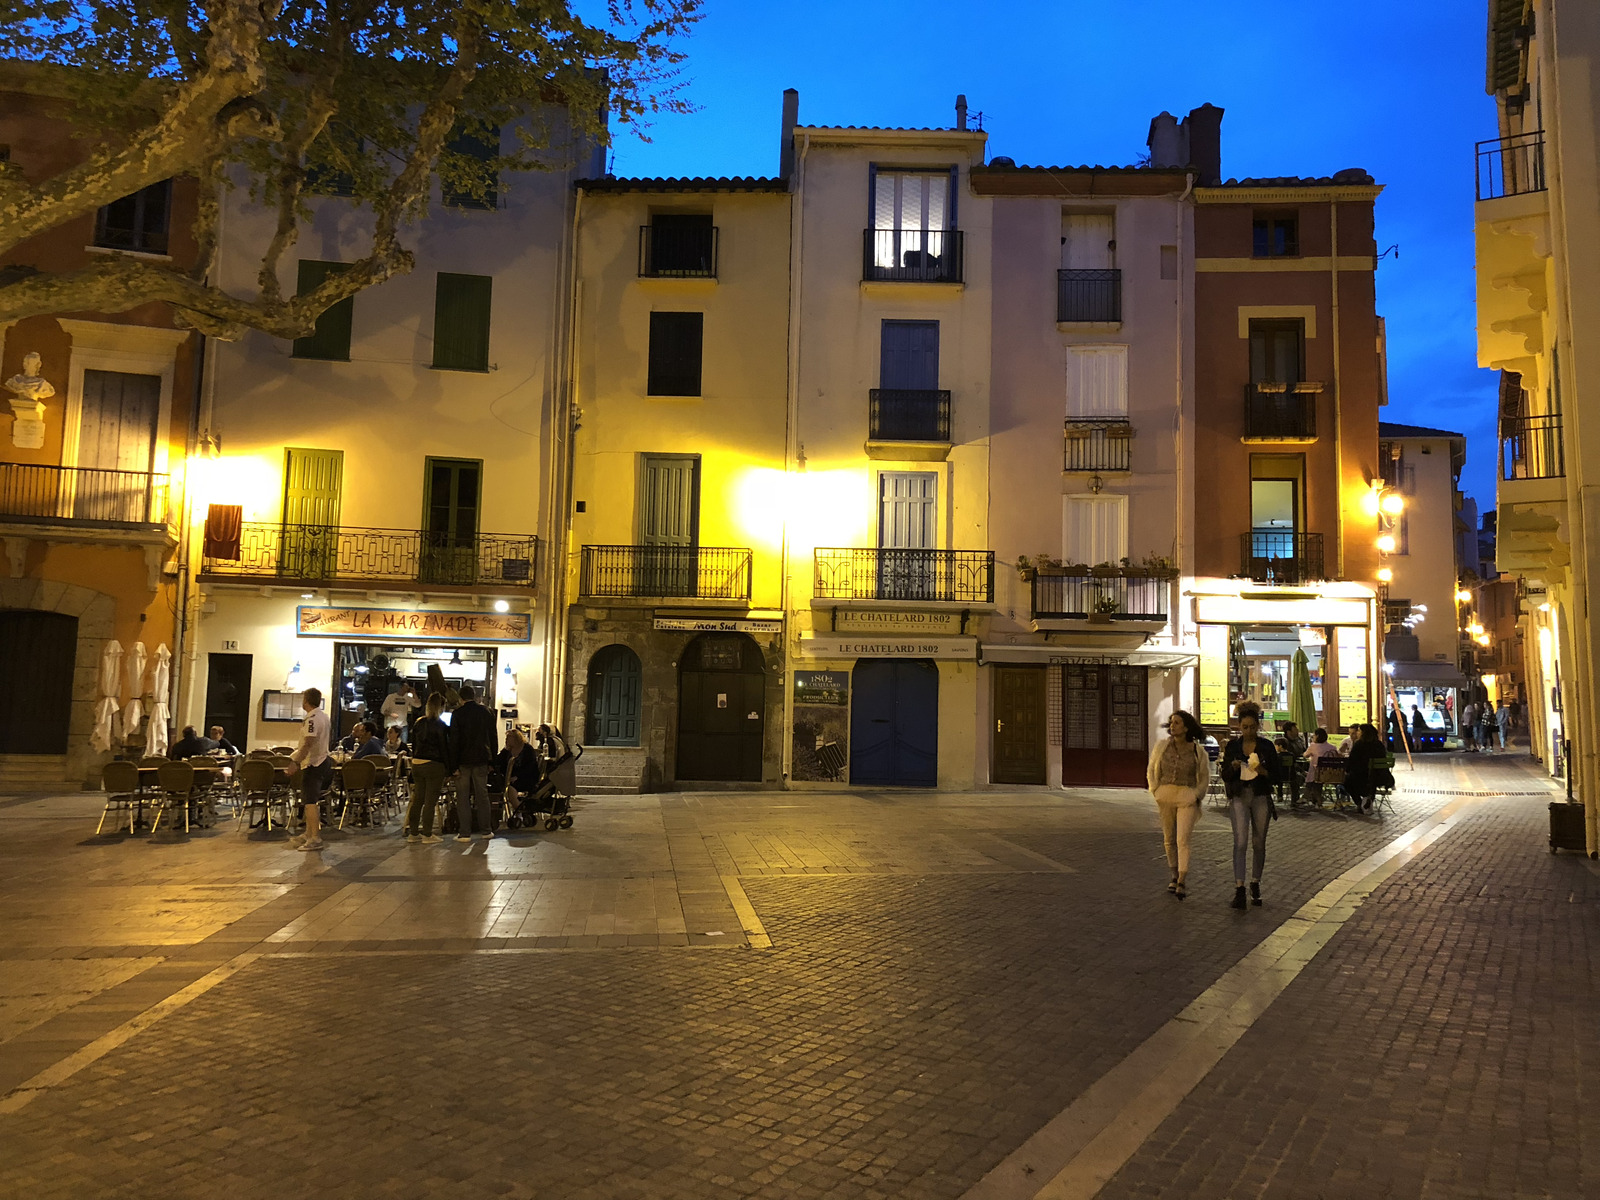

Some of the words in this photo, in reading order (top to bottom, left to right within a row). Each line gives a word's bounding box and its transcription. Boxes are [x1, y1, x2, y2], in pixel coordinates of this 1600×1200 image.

[844, 613, 856, 621] LE
[861, 613, 925, 623] CHATELARD
[928, 615, 950, 623] 1802
[301, 611, 351, 632] RESTAURANT
[353, 612, 372, 628] LA
[383, 614, 478, 631] MARINADE
[482, 617, 522, 638] GRILLADES
[694, 622, 717, 631] Mon
[719, 623, 737, 631] Sud
[226, 641, 236, 650] 14
[839, 645, 852, 653] LE
[854, 645, 915, 654] CHATELARD
[918, 646, 939, 654] 1802
[811, 674, 833, 683] 1802
